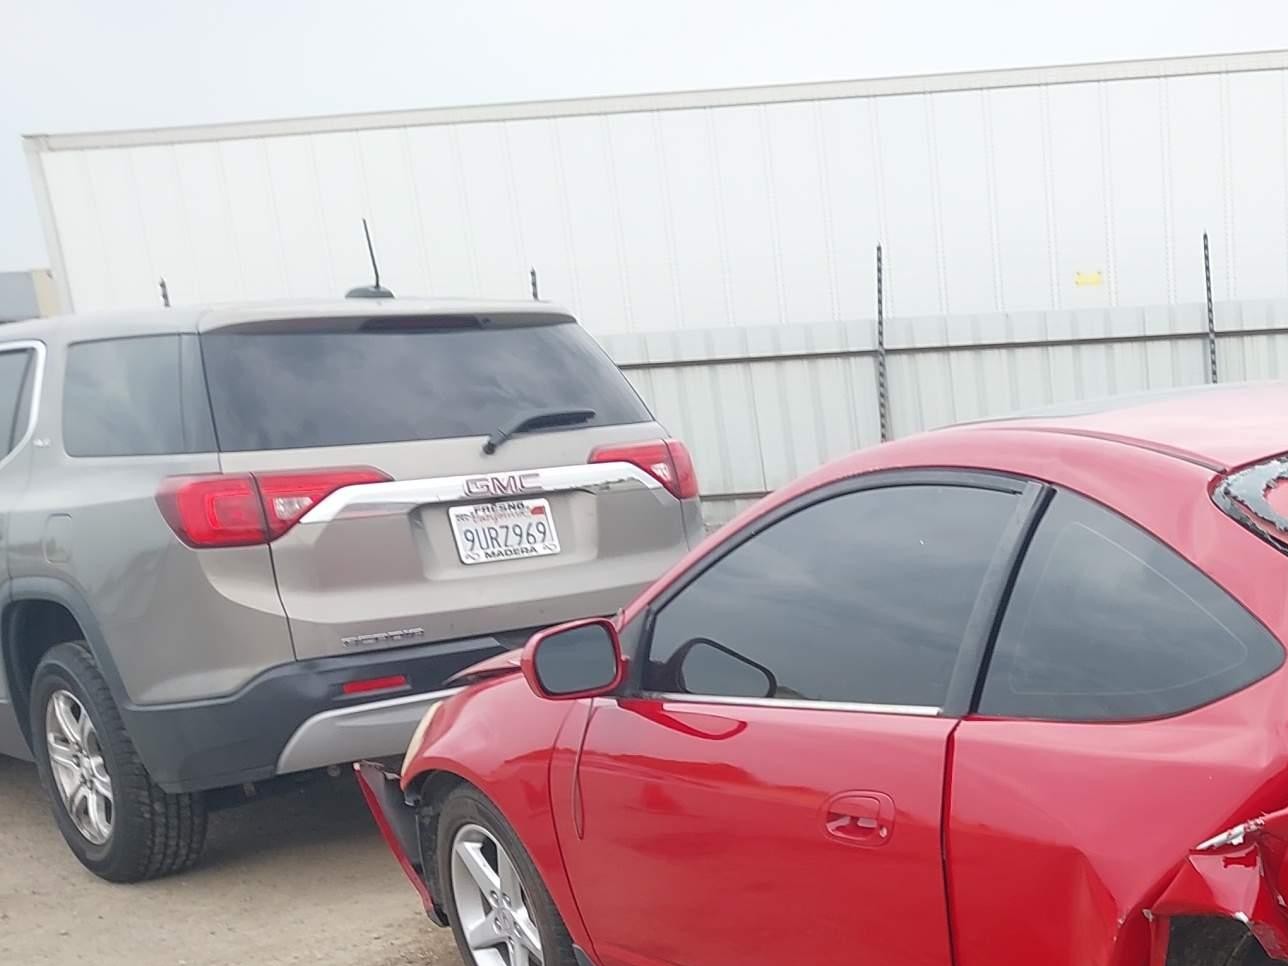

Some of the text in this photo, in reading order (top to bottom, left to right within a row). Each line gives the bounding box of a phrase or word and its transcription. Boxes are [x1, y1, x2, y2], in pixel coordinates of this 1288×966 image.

[463, 473, 543, 497] GMC
[463, 521, 547, 552] 9URZ969
[484, 546, 538, 559] MADERA
